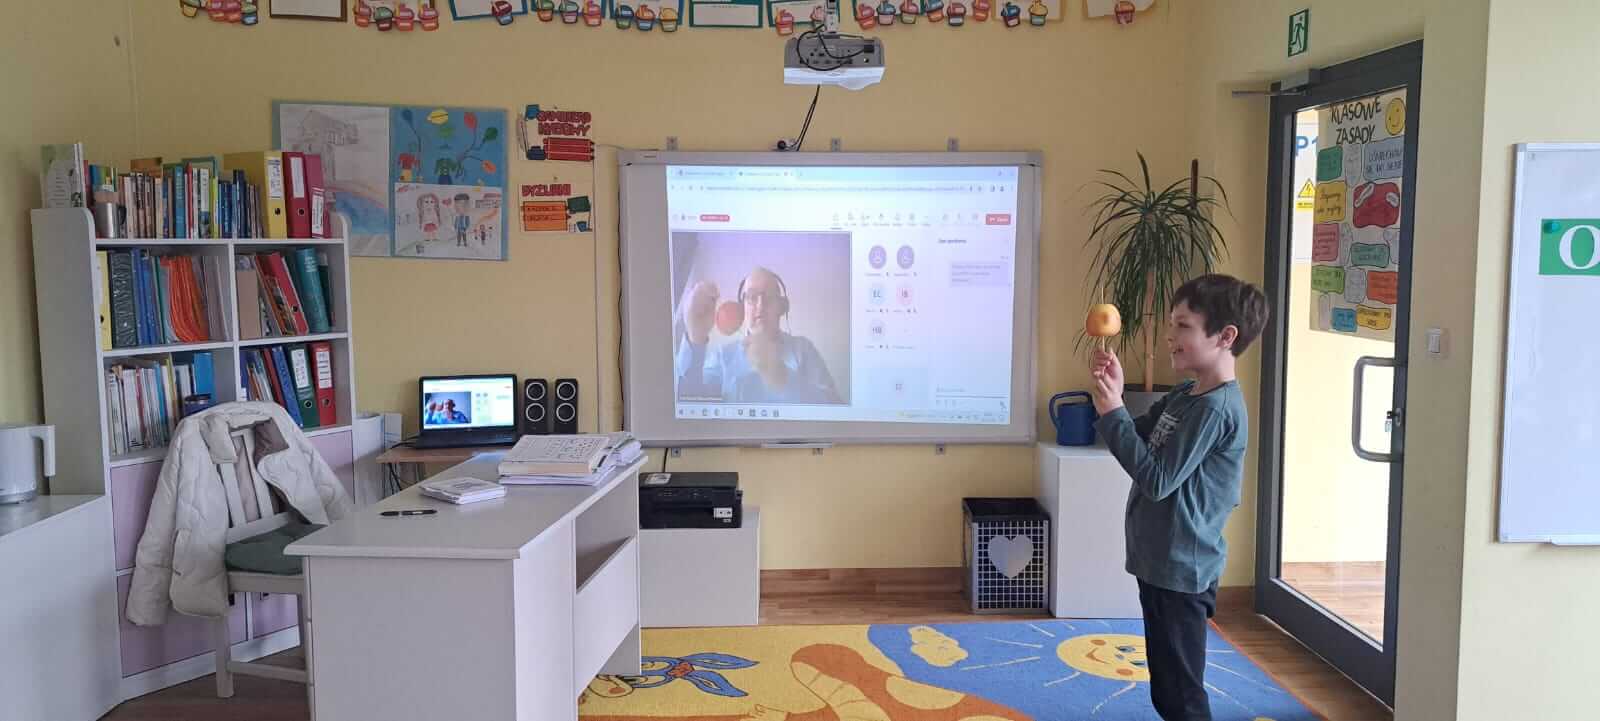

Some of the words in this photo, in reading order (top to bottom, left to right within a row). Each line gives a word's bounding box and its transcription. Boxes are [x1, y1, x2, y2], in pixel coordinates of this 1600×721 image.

[1330, 96, 1381, 125] KLASOWE
[1336, 124, 1375, 145] ZASADY
[1559, 224, 1600, 270] O
